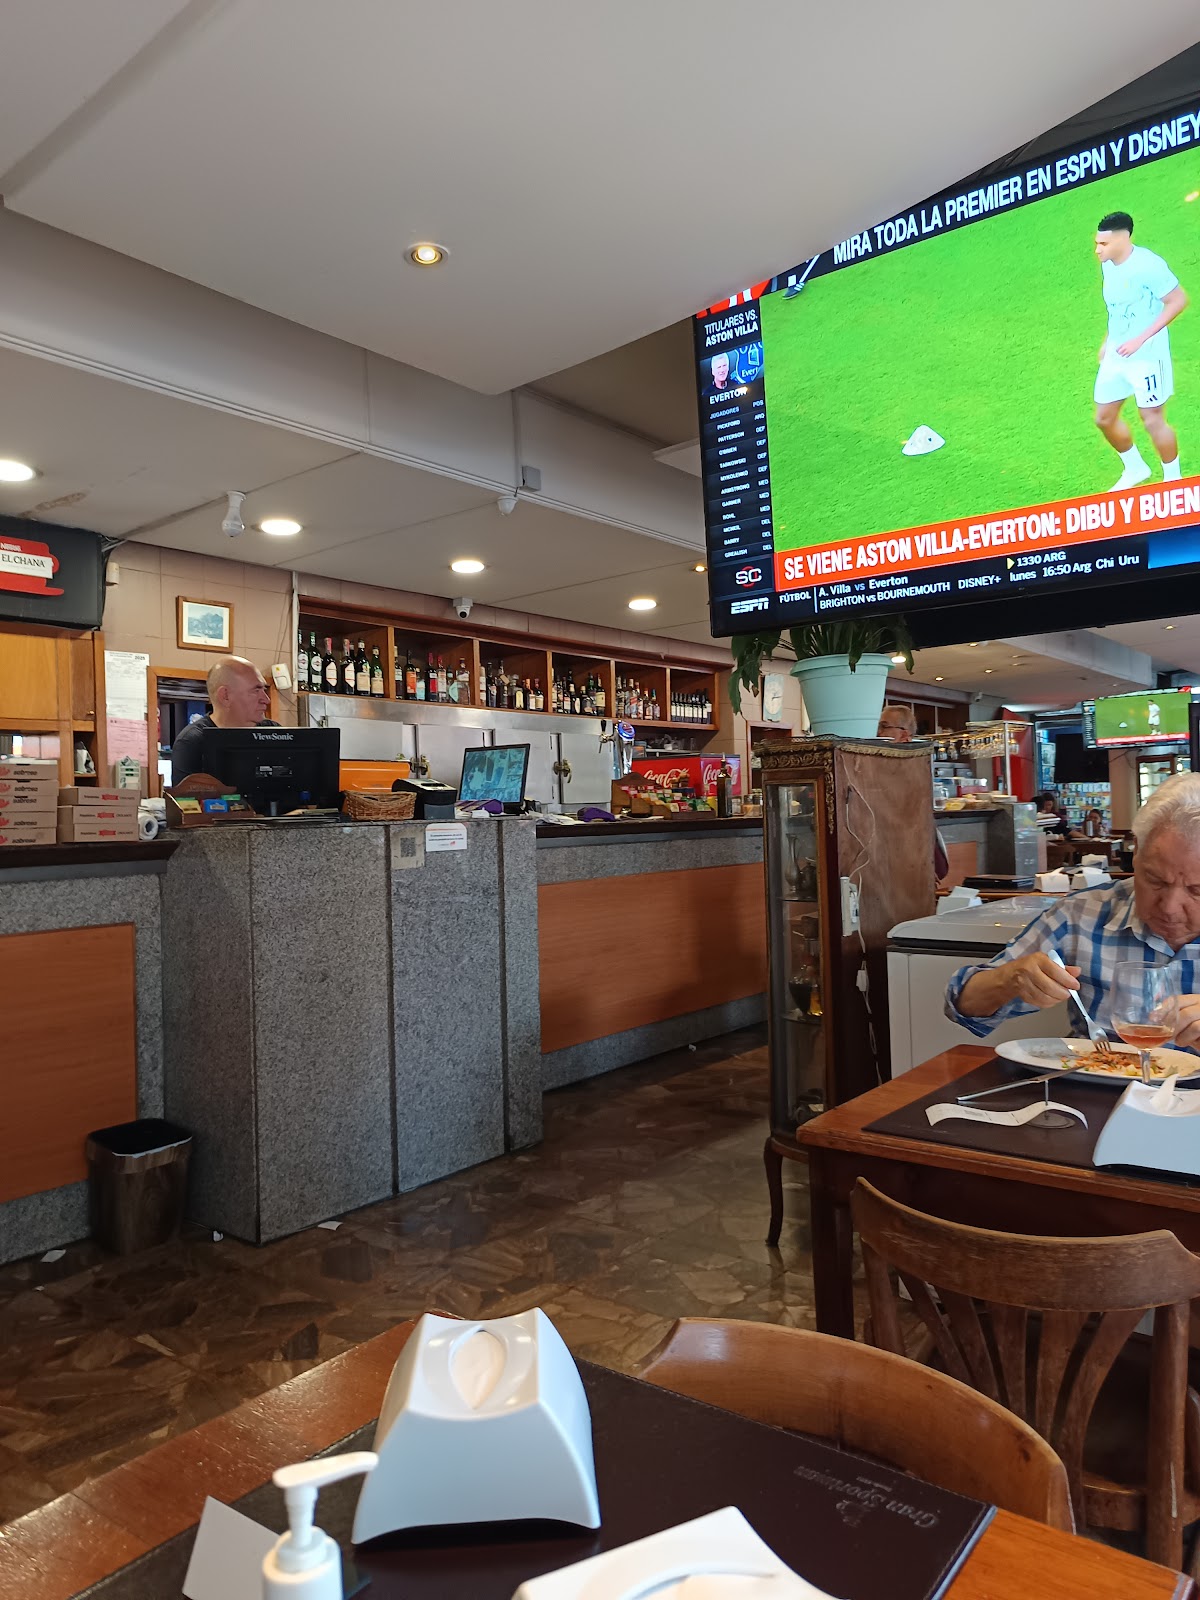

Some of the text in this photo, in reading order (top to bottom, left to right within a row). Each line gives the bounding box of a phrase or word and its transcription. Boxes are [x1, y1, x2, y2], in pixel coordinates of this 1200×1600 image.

[832, 109, 1200, 265] MIRA TODA LA PREMIER EN ESPN Y DISNEY
[704, 309, 758, 335] TITULARES VS.
[705, 321, 759, 347] ASTON VILLA
[709, 386, 748, 405] EVERTON
[784, 485, 1200, 581] SE VIENE ASTON VILLA-EVERTON: DIBU Y BUEN
[1016, 550, 1067, 568] 1330 ARG
[818, 576, 909, 597] A. Villa vs Everton
[819, 554, 1140, 610] BRIGHTON vs BOURNEMOUTH DISNEY+ lunes 16:50 Arg Chi Uru
[730, 597, 770, 615] ESPN
[779, 590, 812, 604] FÚTBOL
[252, 732, 294, 741] ViewSonic
[885, 1500, 938, 1528] Gran
